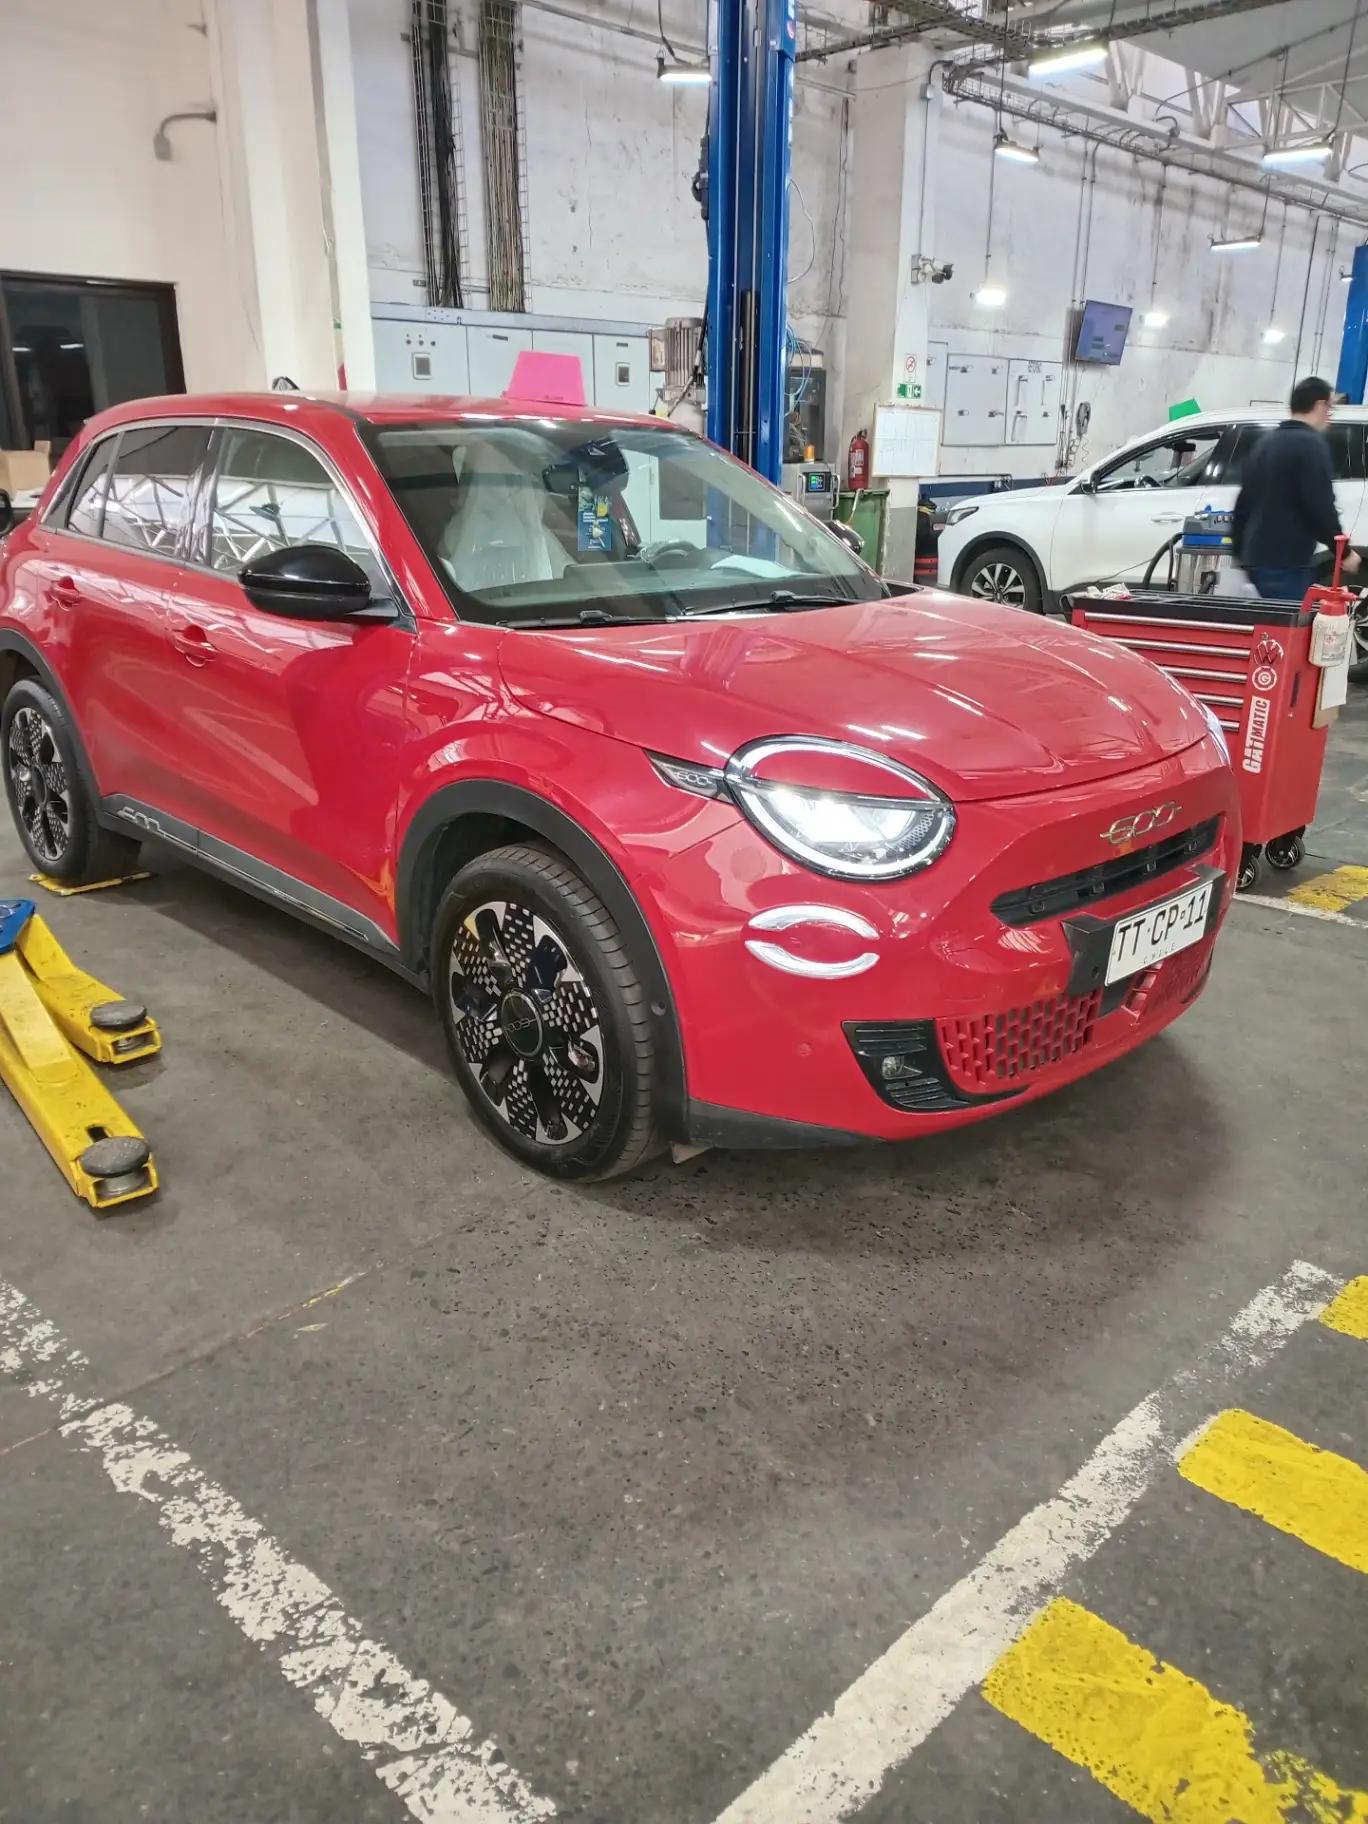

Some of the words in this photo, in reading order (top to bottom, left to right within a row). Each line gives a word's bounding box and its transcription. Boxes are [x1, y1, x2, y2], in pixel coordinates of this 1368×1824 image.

[674, 770, 712, 786] 600
[1100, 801, 1182, 844] 600
[1143, 943, 1176, 964] CHILE
